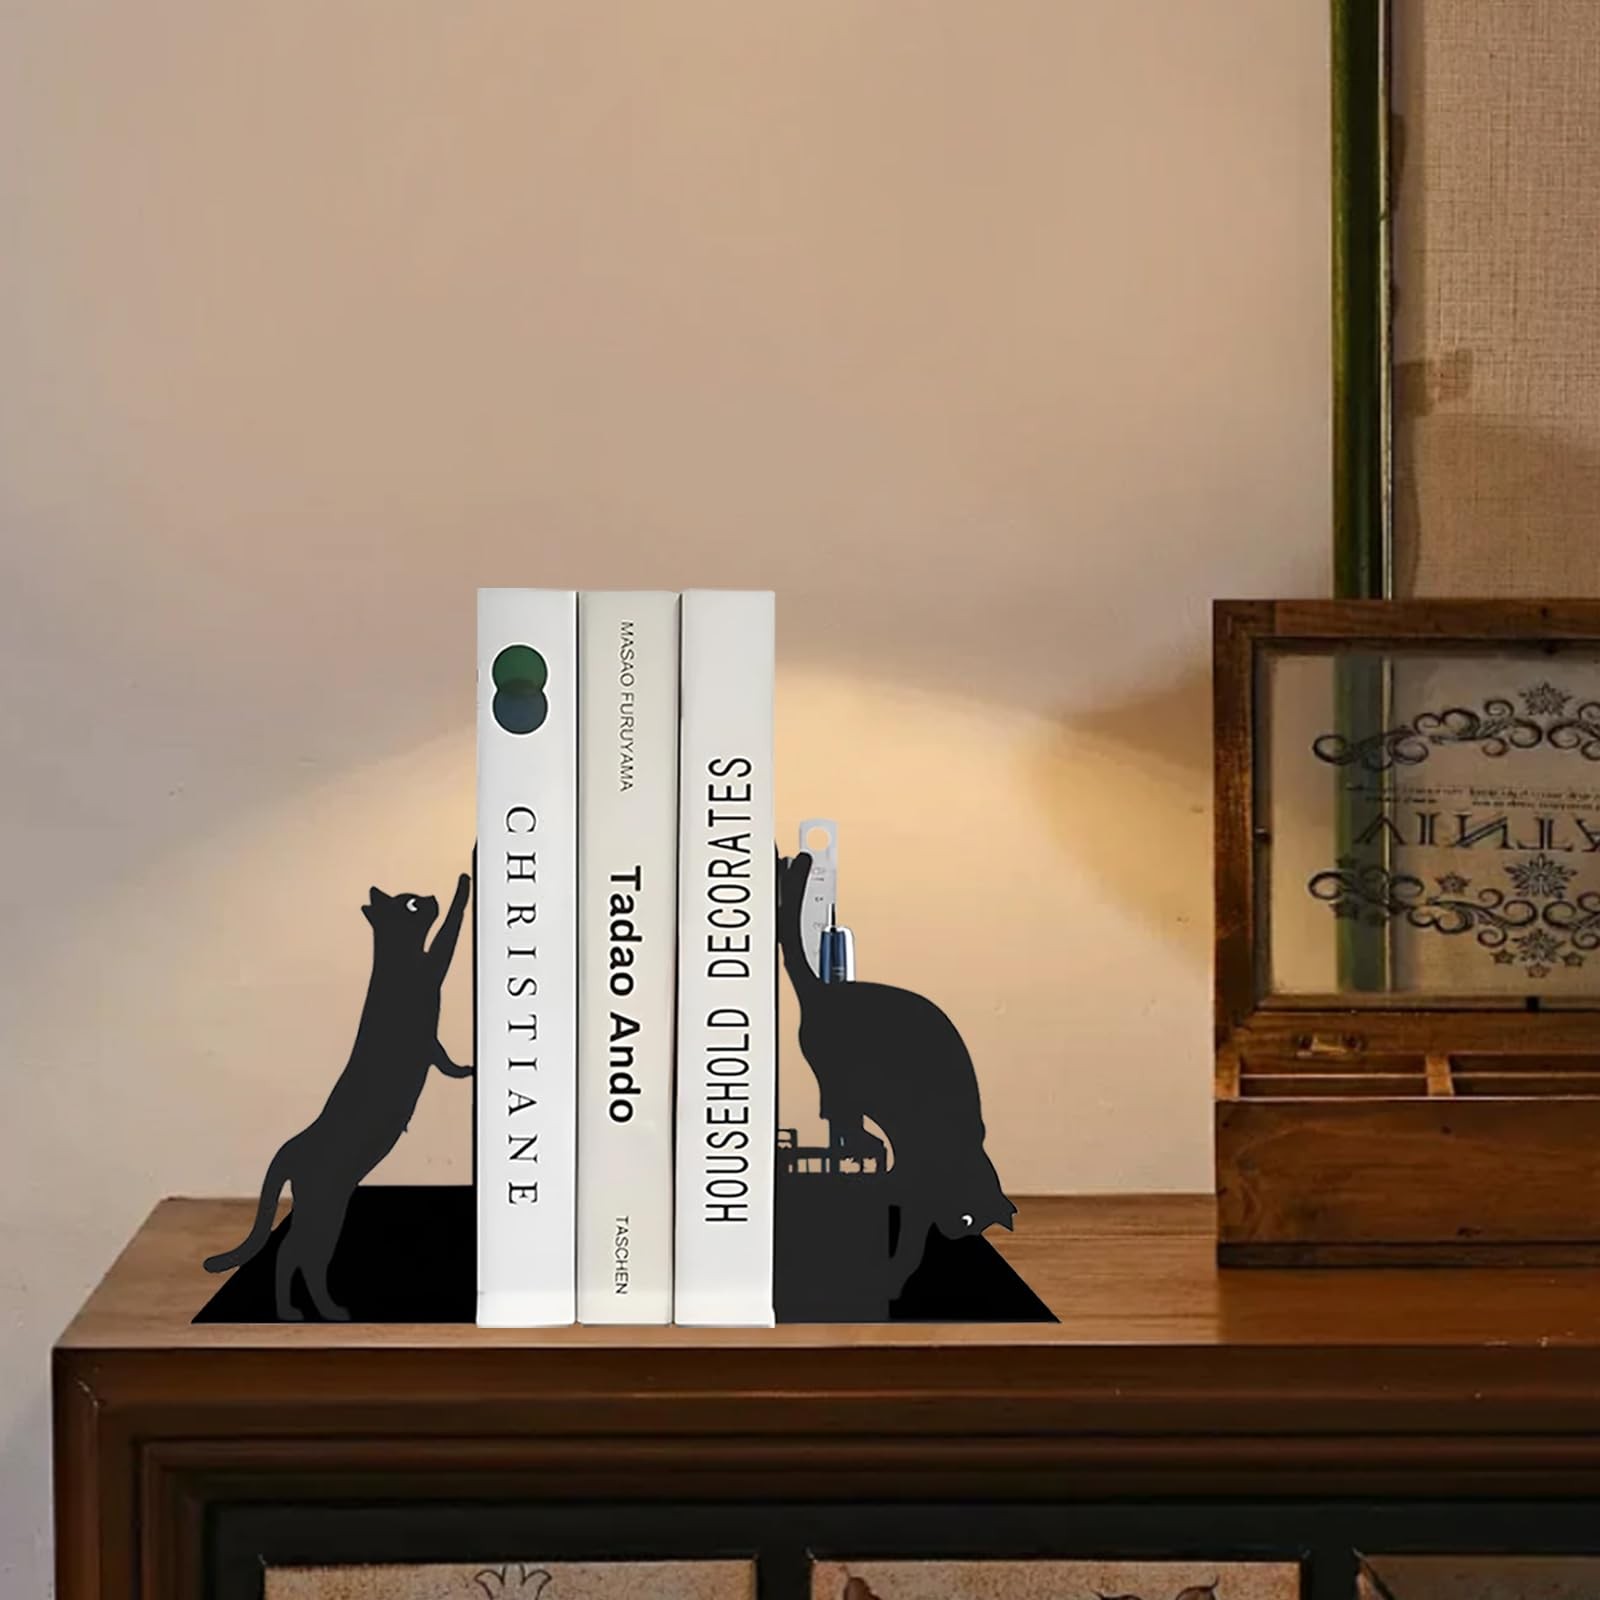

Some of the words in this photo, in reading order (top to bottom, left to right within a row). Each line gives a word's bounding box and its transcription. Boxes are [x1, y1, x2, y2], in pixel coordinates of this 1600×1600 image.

[619, 621, 635, 688] MASAO
[619, 692, 635, 792] FURUYAMA
[707, 757, 752, 978] DECORATES
[609, 864, 643, 997] Tadao
[505, 806, 538, 1205] CHRISTIANE
[608, 1011, 642, 1123] Ando
[704, 1008, 750, 1222] HOUSEHOLD
[614, 1215, 629, 1295] TASCHEN
